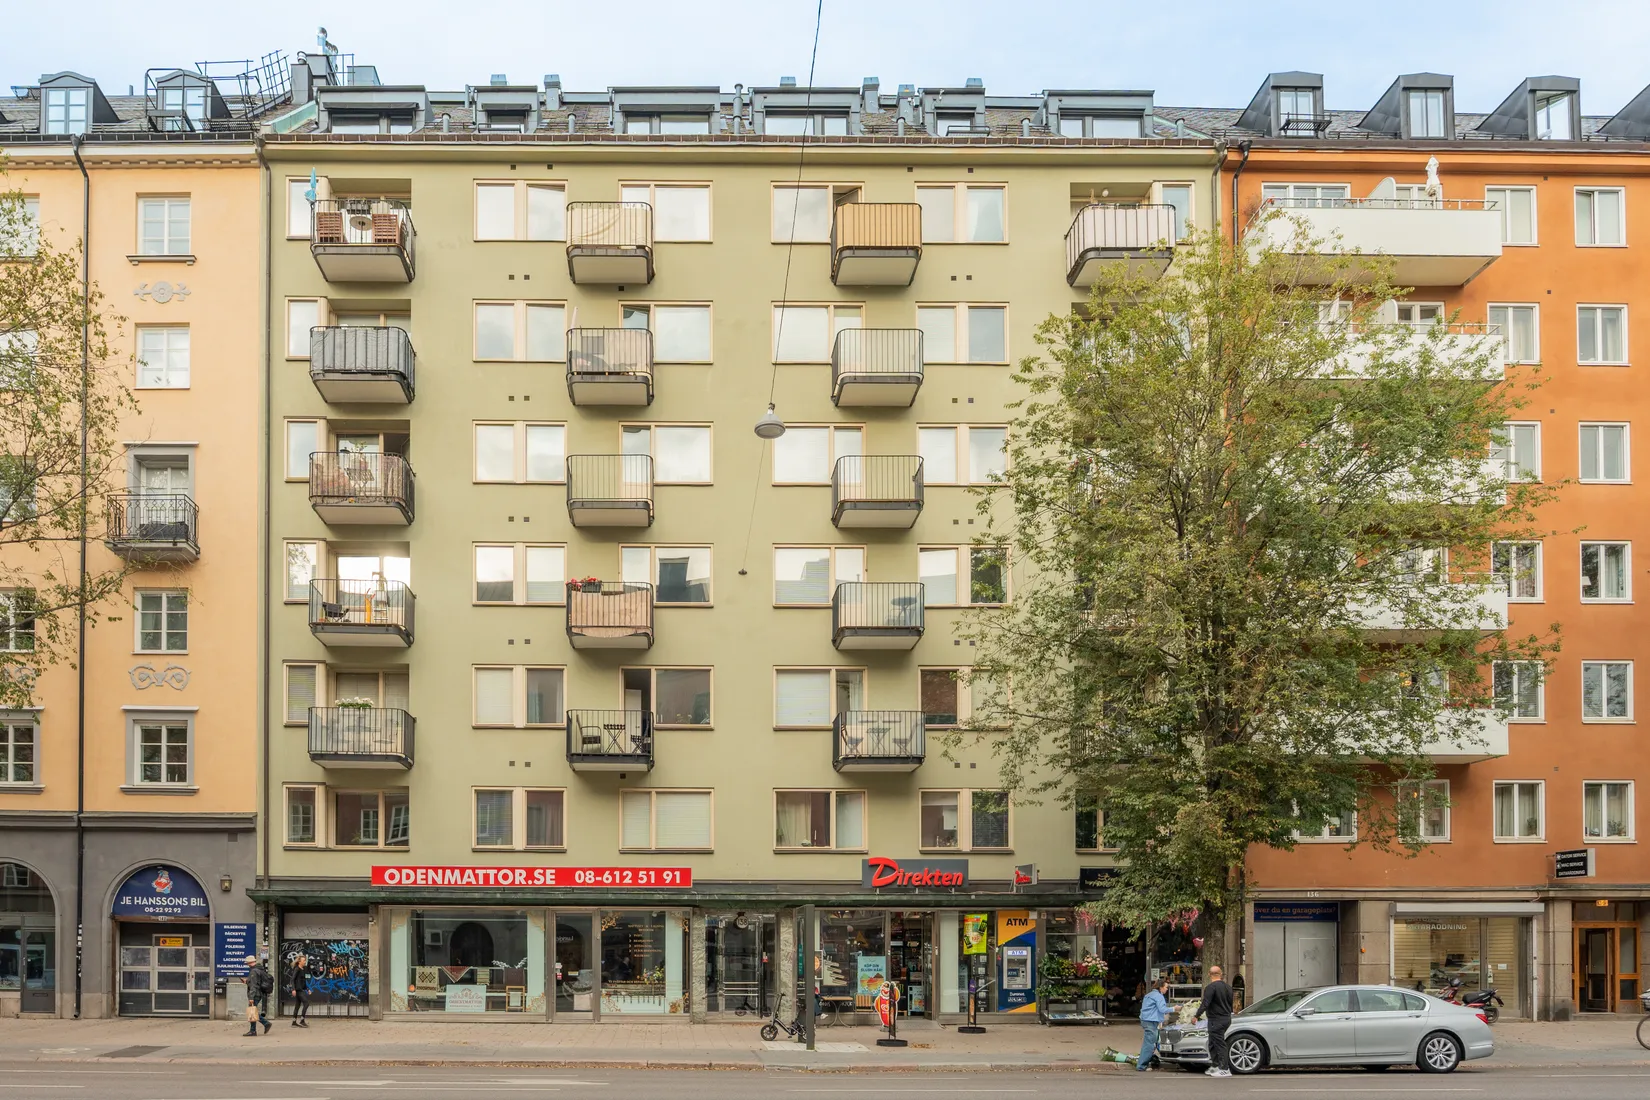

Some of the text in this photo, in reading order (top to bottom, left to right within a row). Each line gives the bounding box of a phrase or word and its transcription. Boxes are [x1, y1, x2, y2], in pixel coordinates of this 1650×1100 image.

[384, 868, 680, 885] ODENMATTOR.SE 08-612 51 91
[868, 857, 964, 887] Direkten
[120, 896, 207, 906] JE HANSSONS BIL
